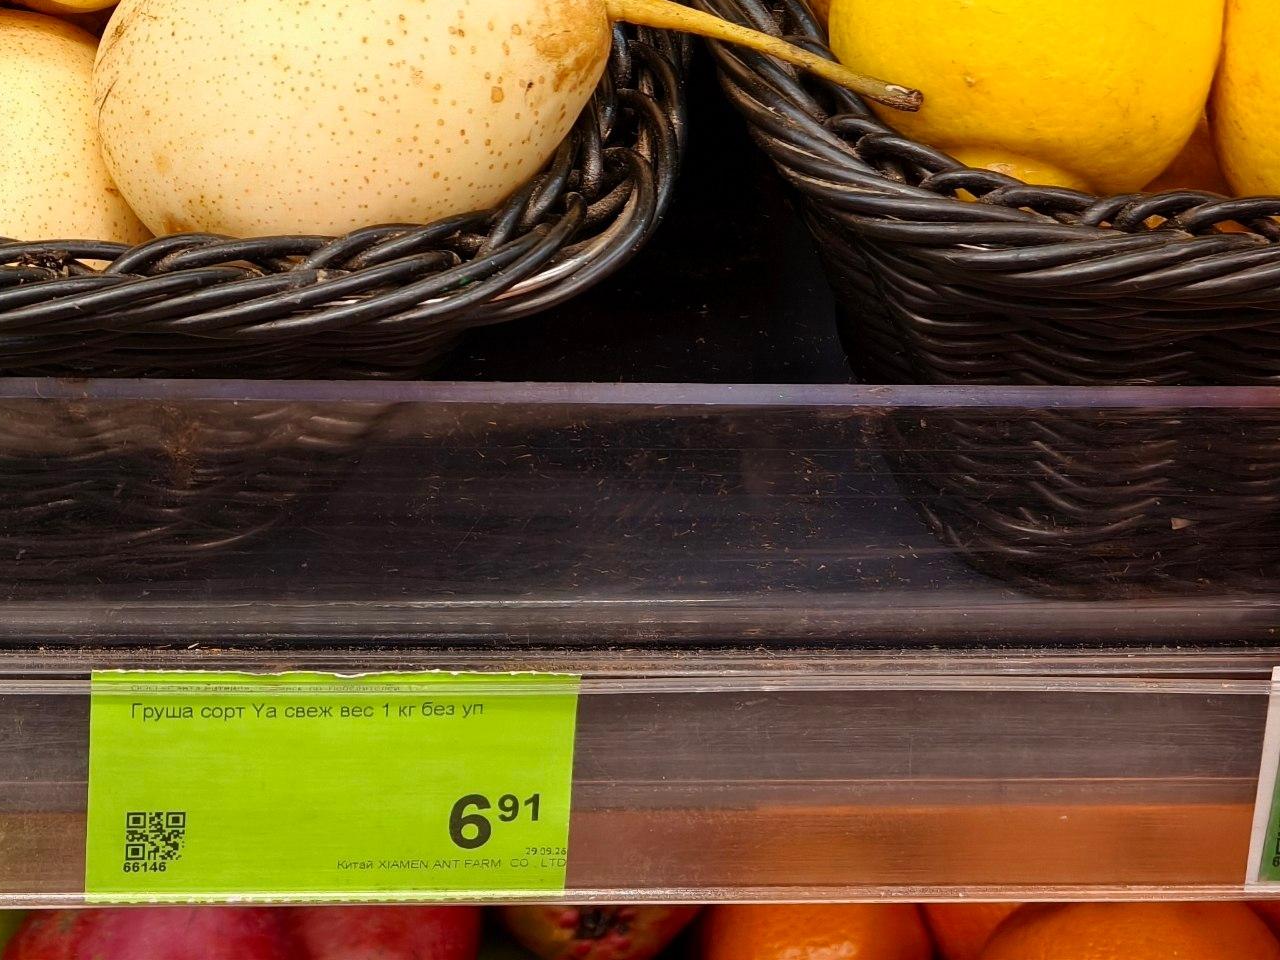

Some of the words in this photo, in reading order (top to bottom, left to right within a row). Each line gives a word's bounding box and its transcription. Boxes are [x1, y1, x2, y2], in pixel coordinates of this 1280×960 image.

[131, 703, 194, 722] Груша
[200, 707, 246, 722] сорт
[252, 703, 277, 719] Ya
[284, 705, 333, 719] свеж
[340, 705, 375, 718] вес
[382, 702, 390, 718] 1
[398, 704, 416, 718] кг
[421, 701, 456, 717] без
[462, 703, 484, 719] уп
[448, 793, 492, 850] 6
[497, 793, 542, 823] 91
[122, 861, 167, 874] 66146
[336, 858, 374, 870] Китай
[378, 859, 429, 870] XIAMEN
[431, 859, 461, 869] ANT
[464, 858, 502, 869] FARM
